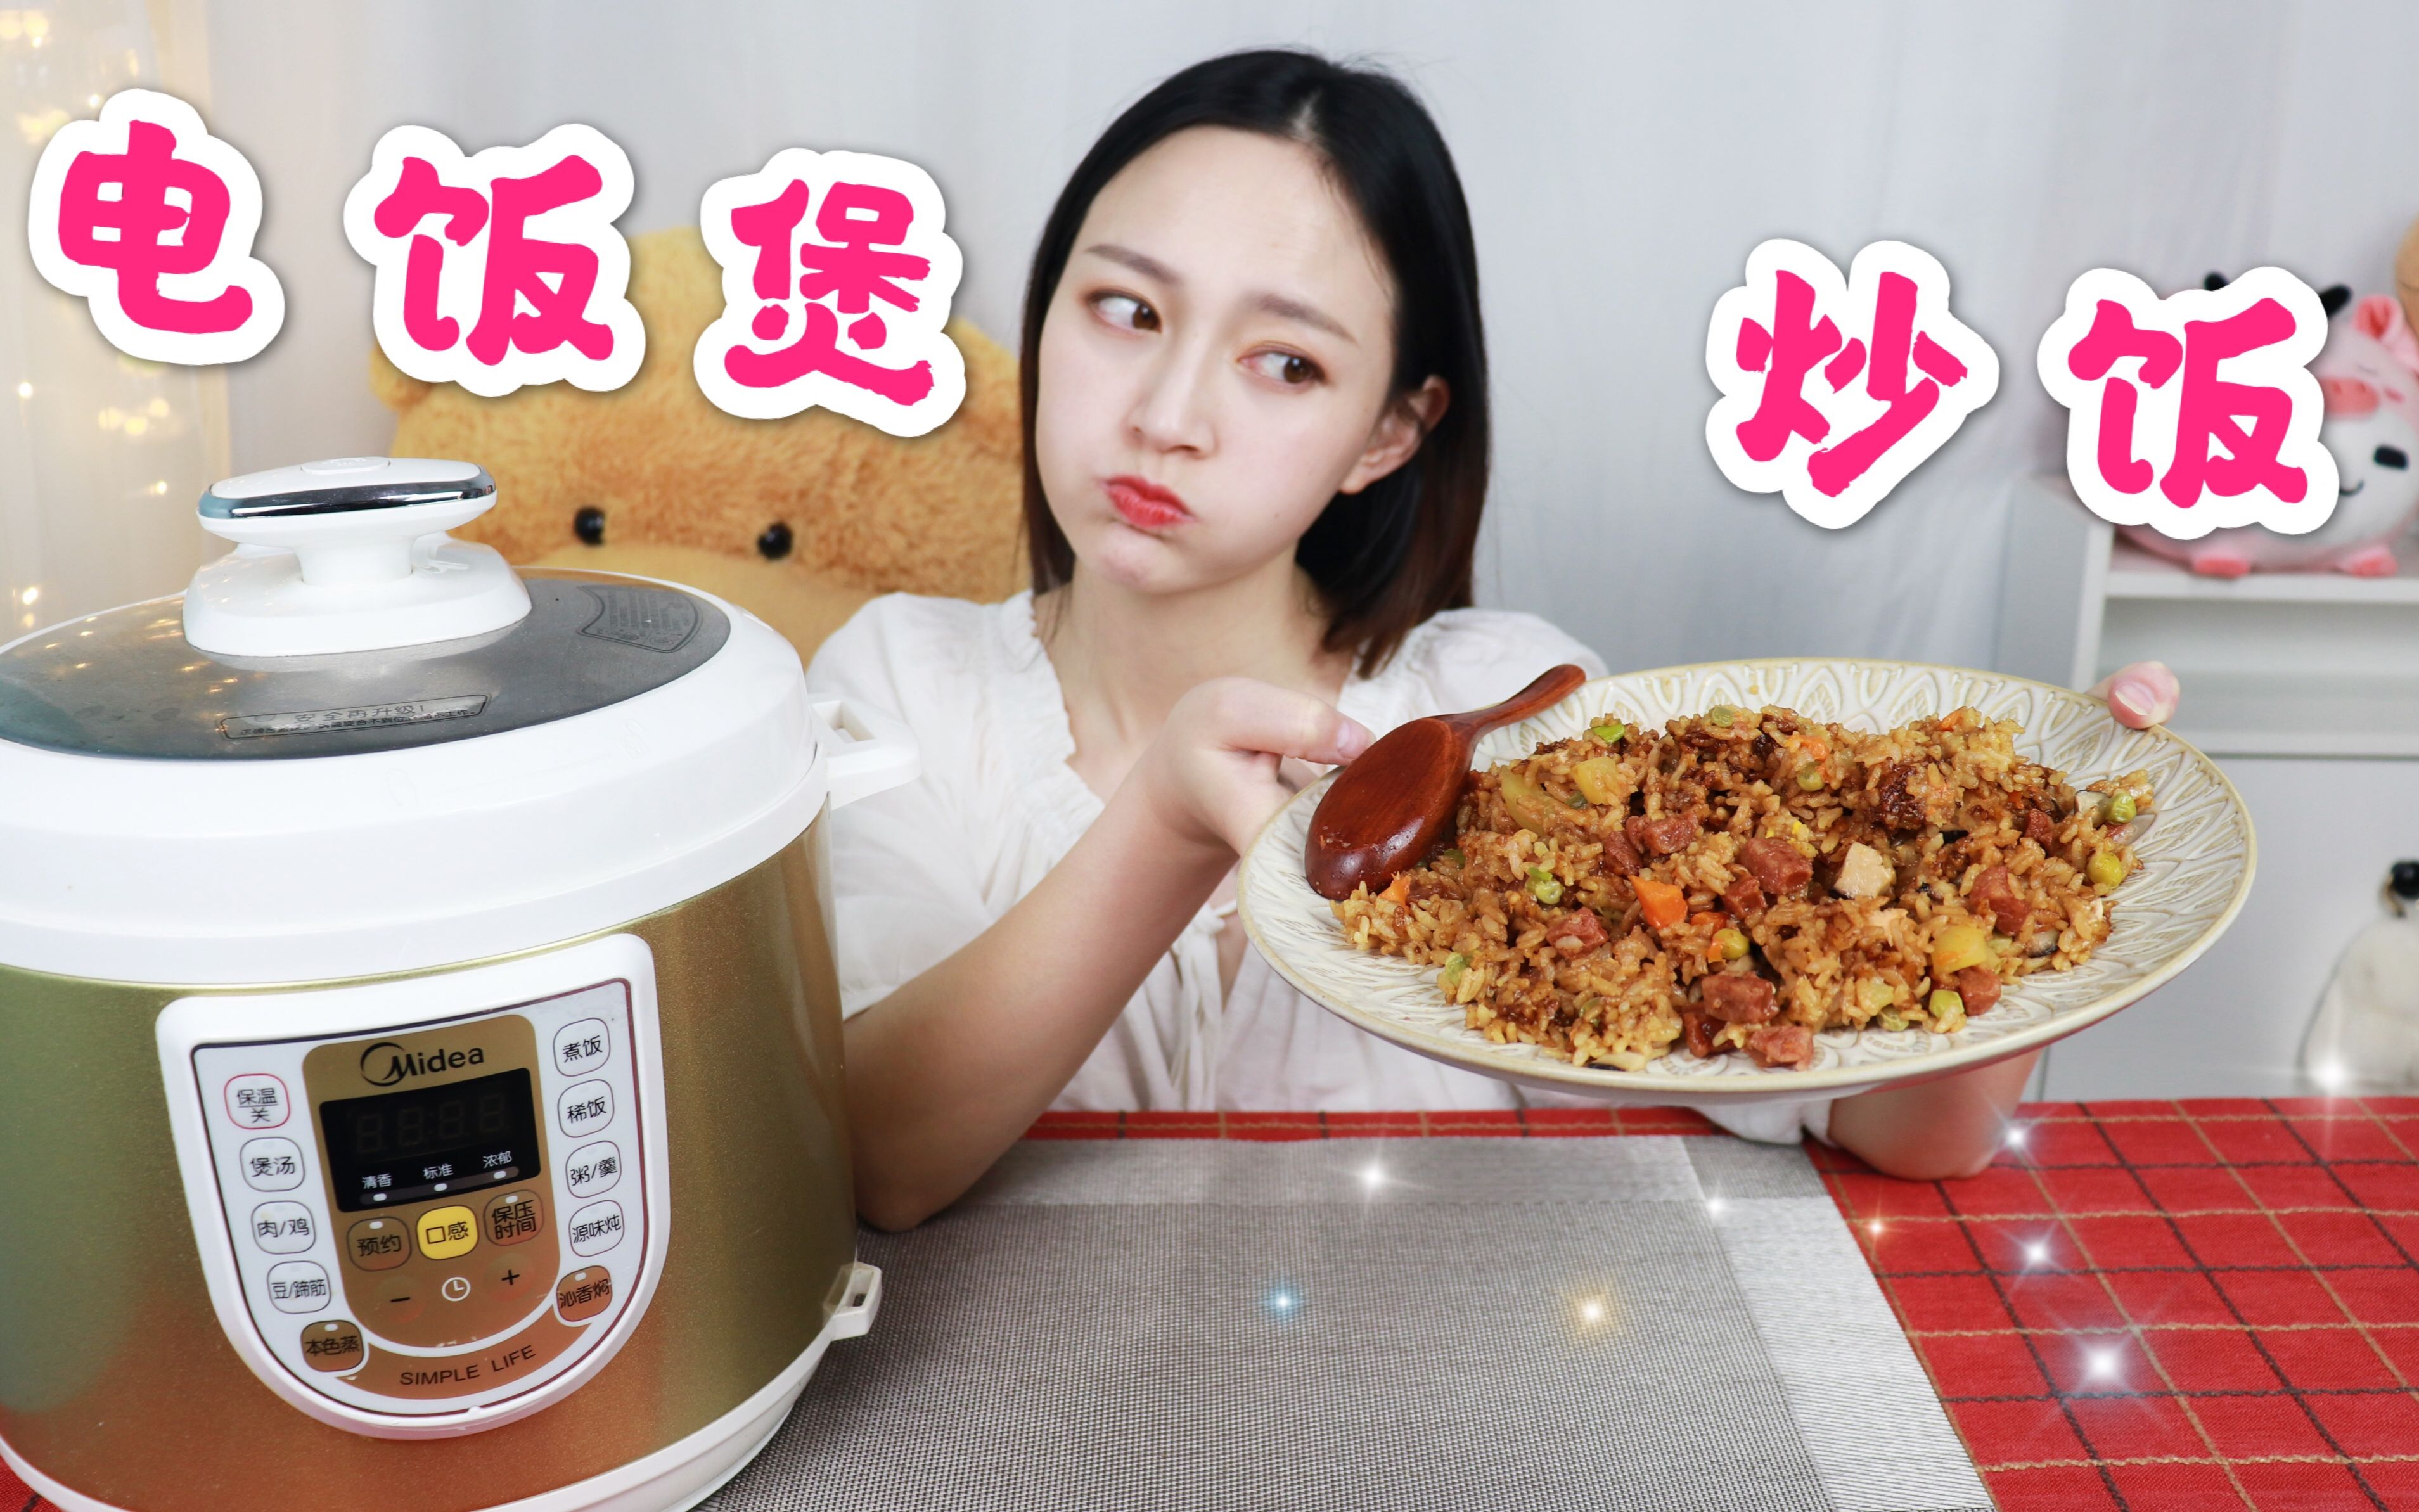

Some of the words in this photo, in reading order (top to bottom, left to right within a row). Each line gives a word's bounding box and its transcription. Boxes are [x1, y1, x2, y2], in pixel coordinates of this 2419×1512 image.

[562, 1035, 603, 1063] 煮饭
[359, 1041, 485, 1087] Midea
[236, 1087, 278, 1105] 保温
[250, 1107, 271, 1123] 关
[567, 1096, 607, 1124] 稀饭
[250, 1156, 295, 1177] 煲汤
[482, 1150, 513, 1169] 浓郁
[570, 1156, 618, 1186] 粥/羹
[361, 1173, 392, 1189] 清香
[423, 1163, 454, 1180] 标准
[491, 1199, 535, 1225] 保压
[257, 1218, 310, 1238] 肉/鸡
[426, 1221, 470, 1245] 口感
[494, 1215, 537, 1240] 时间
[572, 1214, 622, 1244] 源味炖
[357, 1234, 402, 1257] 预约
[271, 1279, 327, 1299] 豆/蹄筋
[559, 1278, 610, 1309] 沁香焖
[305, 1335, 361, 1357] 本色蒸
[399, 1364, 480, 1386] SIMPLE
[491, 1344, 537, 1372] LIFE
